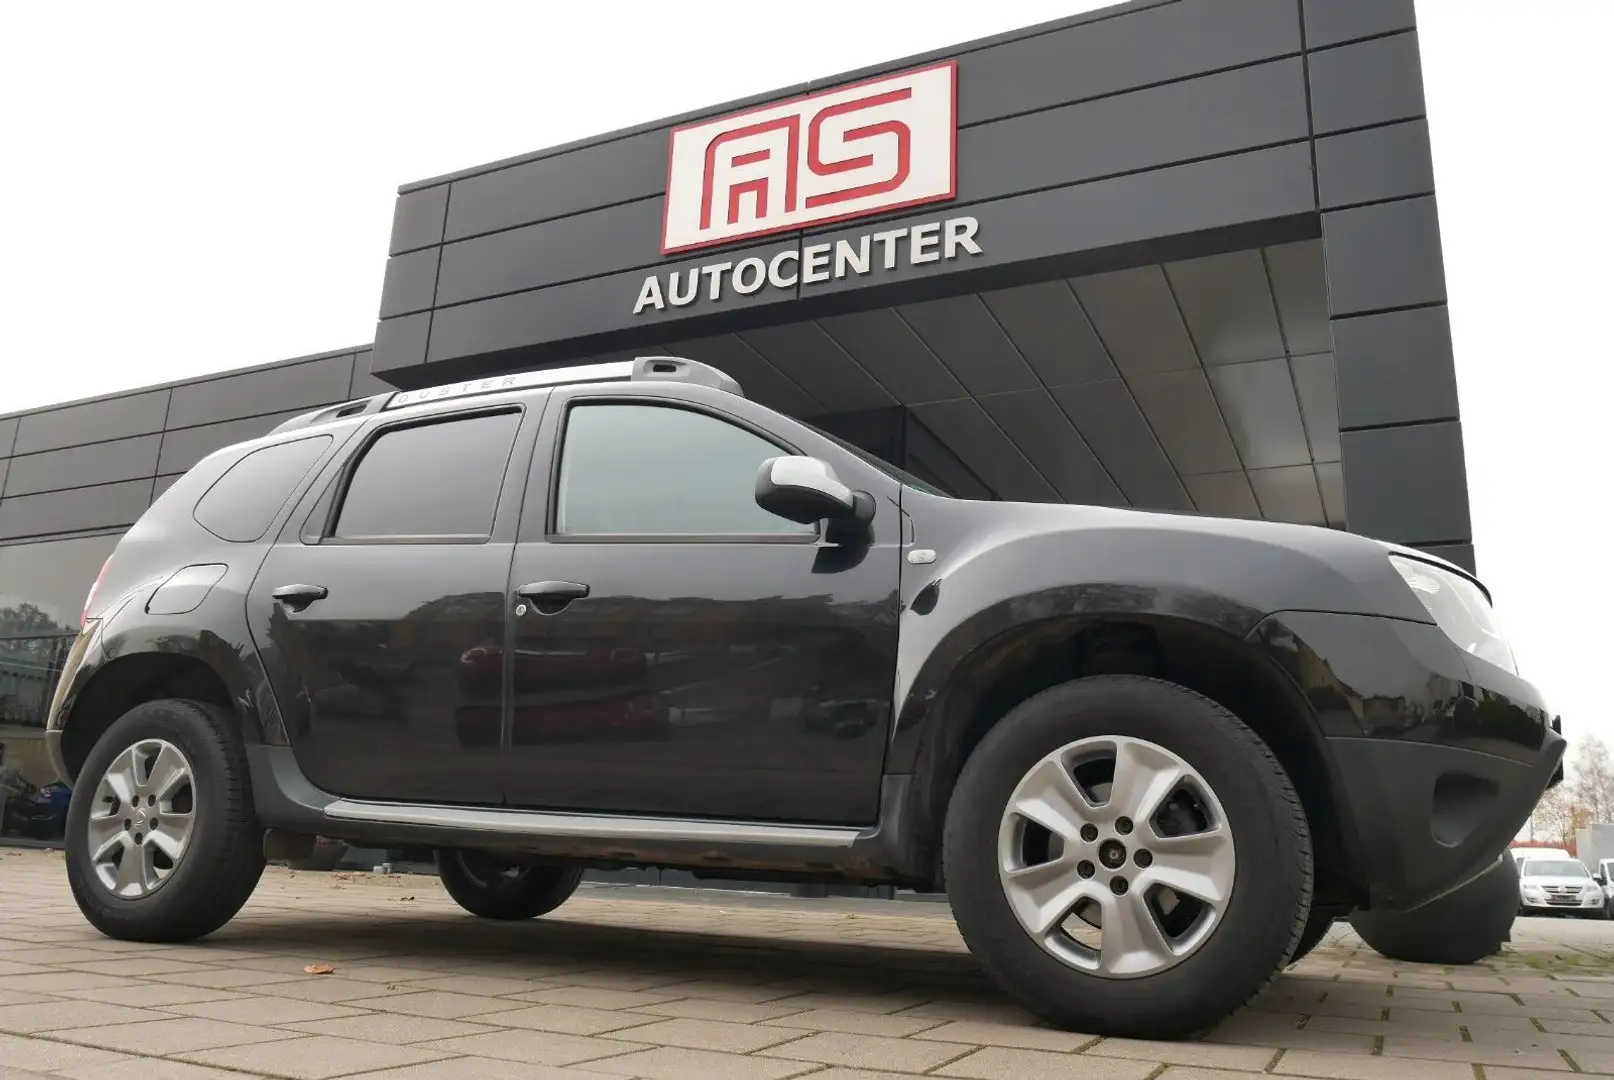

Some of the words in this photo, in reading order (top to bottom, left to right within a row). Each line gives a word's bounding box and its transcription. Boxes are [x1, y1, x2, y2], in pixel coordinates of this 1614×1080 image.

[700, 87, 911, 230] AS
[633, 216, 983, 314] AUTOCENTER
[398, 376, 517, 404] DUSTER
